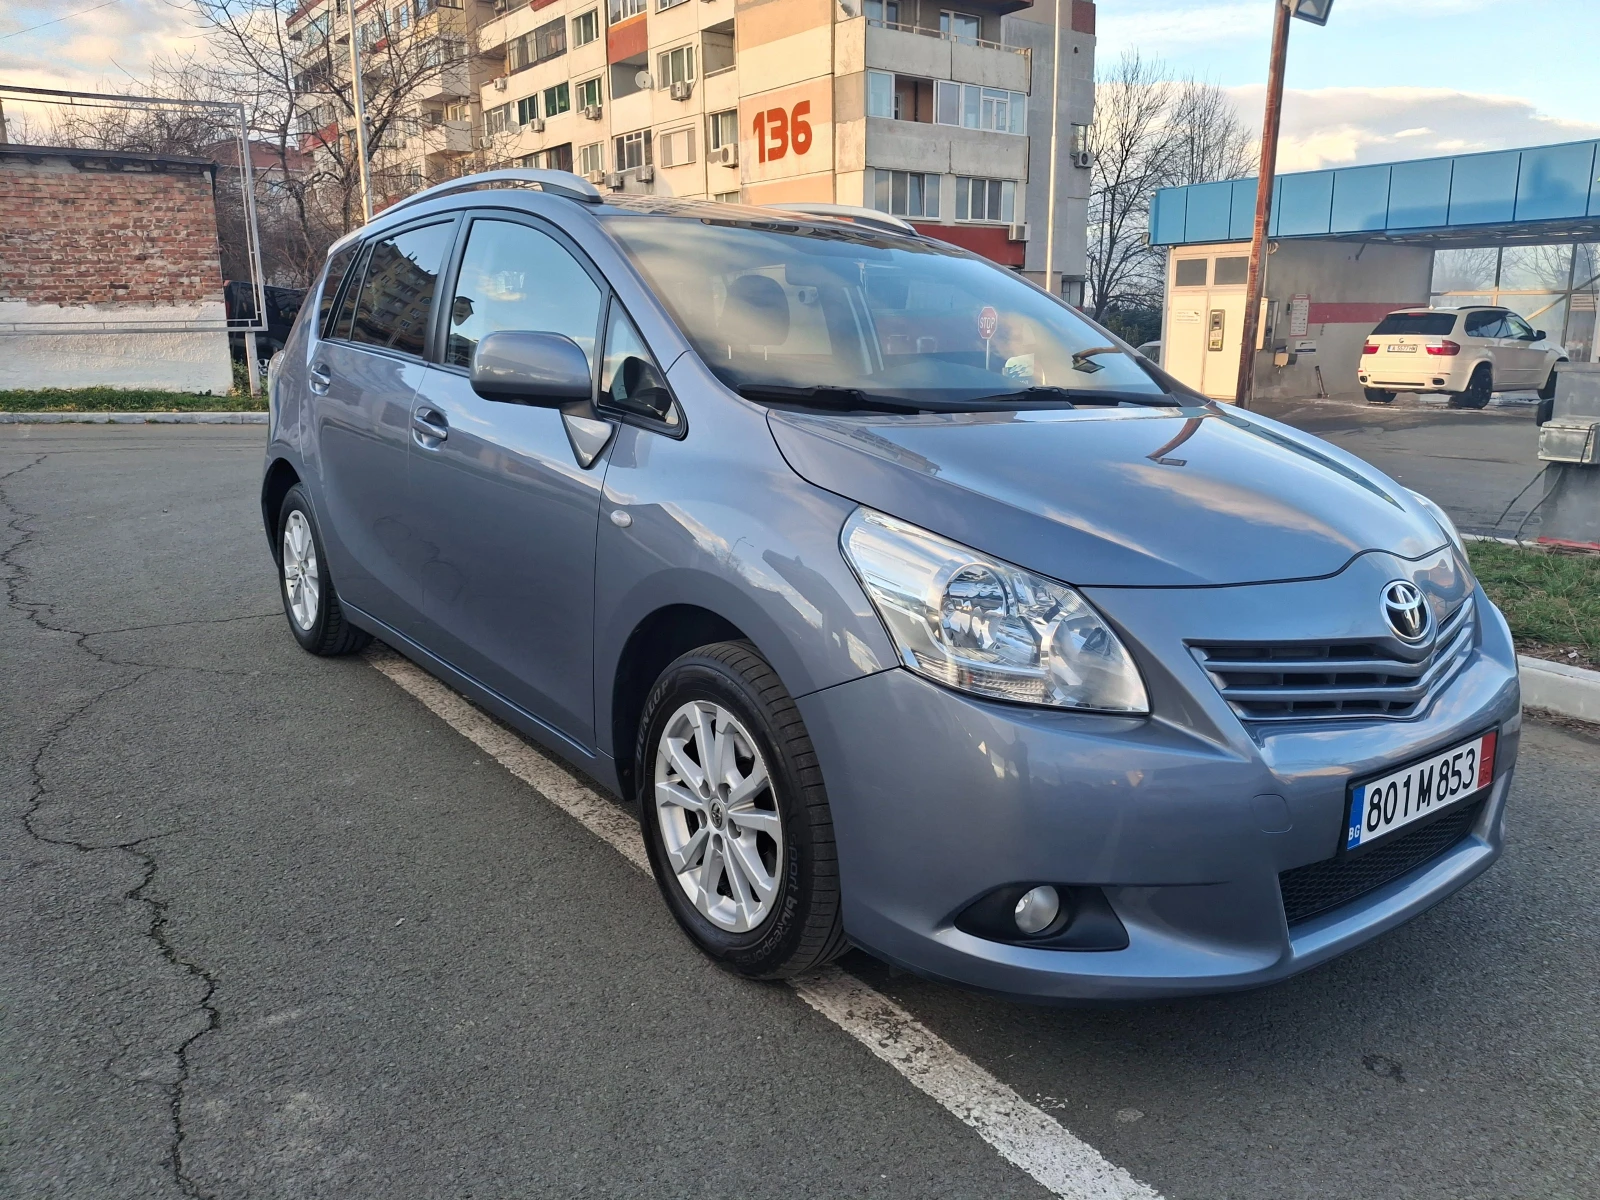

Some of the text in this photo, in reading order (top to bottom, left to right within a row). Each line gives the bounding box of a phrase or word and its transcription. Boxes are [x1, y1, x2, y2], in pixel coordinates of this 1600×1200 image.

[753, 100, 812, 163] 136
[980, 317, 995, 329] STOP
[637, 679, 669, 763] DUNLOP
[1348, 824, 1361, 841] BG
